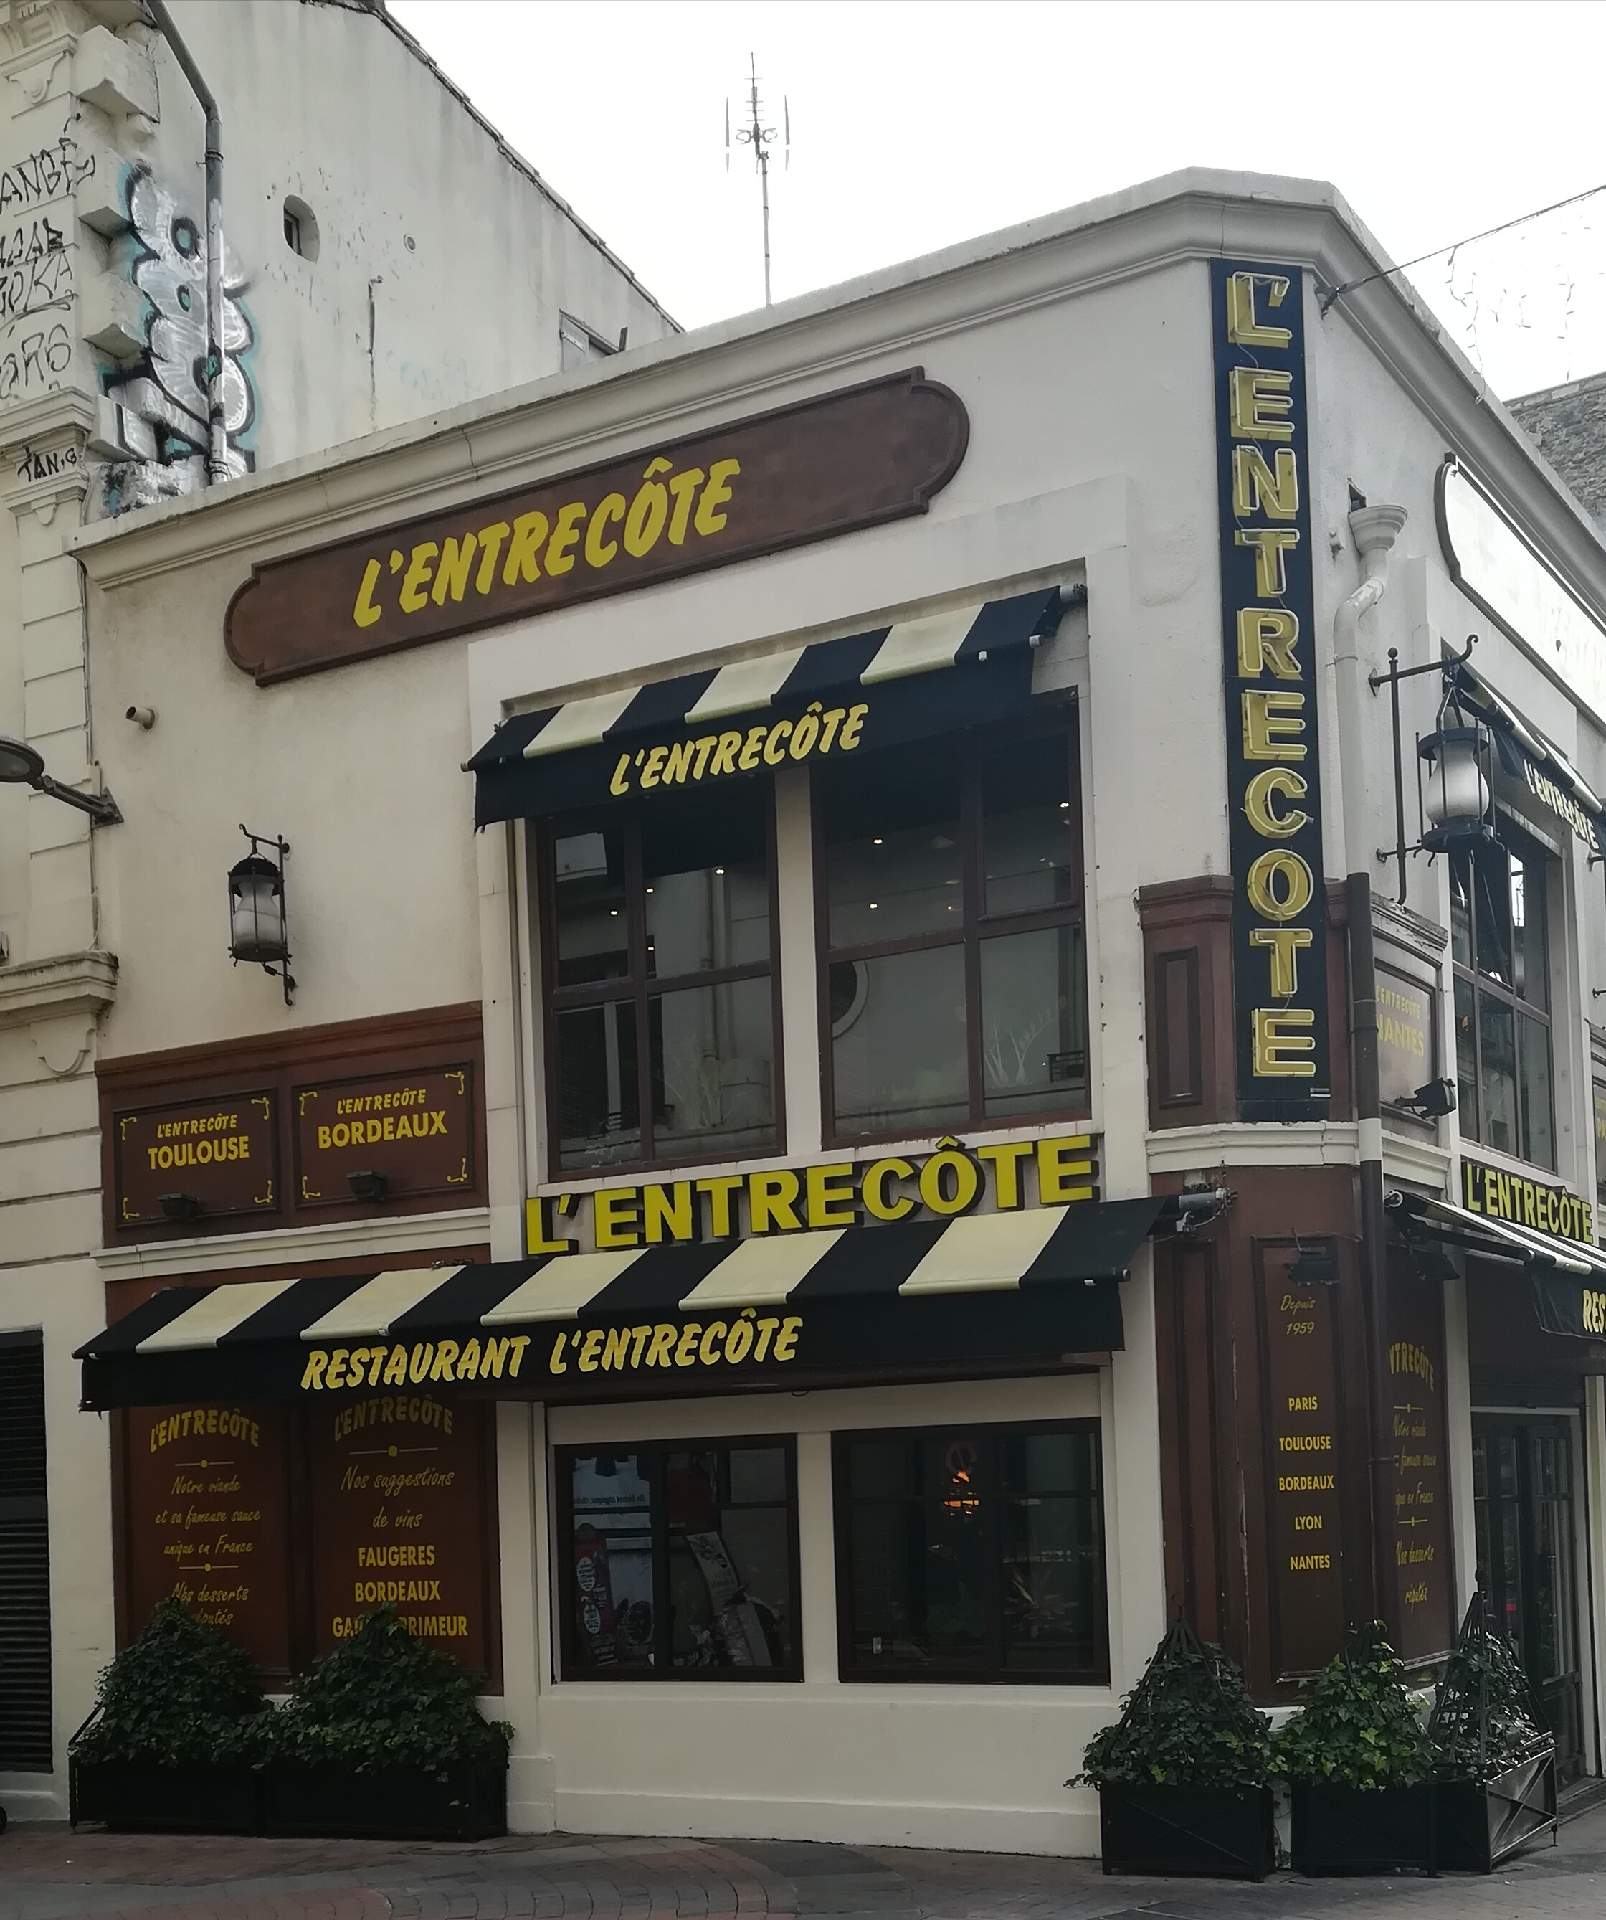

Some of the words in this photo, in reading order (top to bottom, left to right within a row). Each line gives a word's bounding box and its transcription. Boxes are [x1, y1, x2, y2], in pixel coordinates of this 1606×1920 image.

[353, 457, 741, 628] L'ENTRECÔTE
[609, 701, 869, 796] L'ENTRECÔTE
[337, 1088, 427, 1115] L'ENTRECÔTE
[157, 1113, 238, 1139] L'ENTRECÔTE
[318, 1111, 447, 1149] BORDEAUX
[148, 1136, 250, 1170] TOULOUSE
[526, 1135, 1093, 1255] L'ENTRECÔTE
[1467, 1163, 1593, 1242] L'ENTRECÔTE
[1280, 1294, 1316, 1315] Depuis
[1286, 1321, 1314, 1335] 1959
[300, 1336, 531, 1390] RESTAURANT
[549, 1307, 804, 1374] L'ENTRECÔTE
[1288, 1396, 1318, 1412] PARIS
[335, 1395, 454, 1441] L'ENTRECÔTE
[150, 1408, 261, 1453] L'ENTRECÔTE
[1279, 1436, 1331, 1452] TOULOUSE
[340, 1465, 368, 1491] Nos
[373, 1469, 456, 1496] suggestions
[1278, 1475, 1335, 1492] BORDEAUX
[373, 1508, 389, 1528] de
[394, 1510, 423, 1527] vins
[1295, 1515, 1322, 1531] LYON
[215, 1534, 254, 1555] France
[358, 1545, 436, 1568] FAUGERES
[1290, 1554, 1330, 1571] NANTES
[197, 1584, 248, 1602] desserts
[355, 1580, 441, 1602] BORDEAUX
